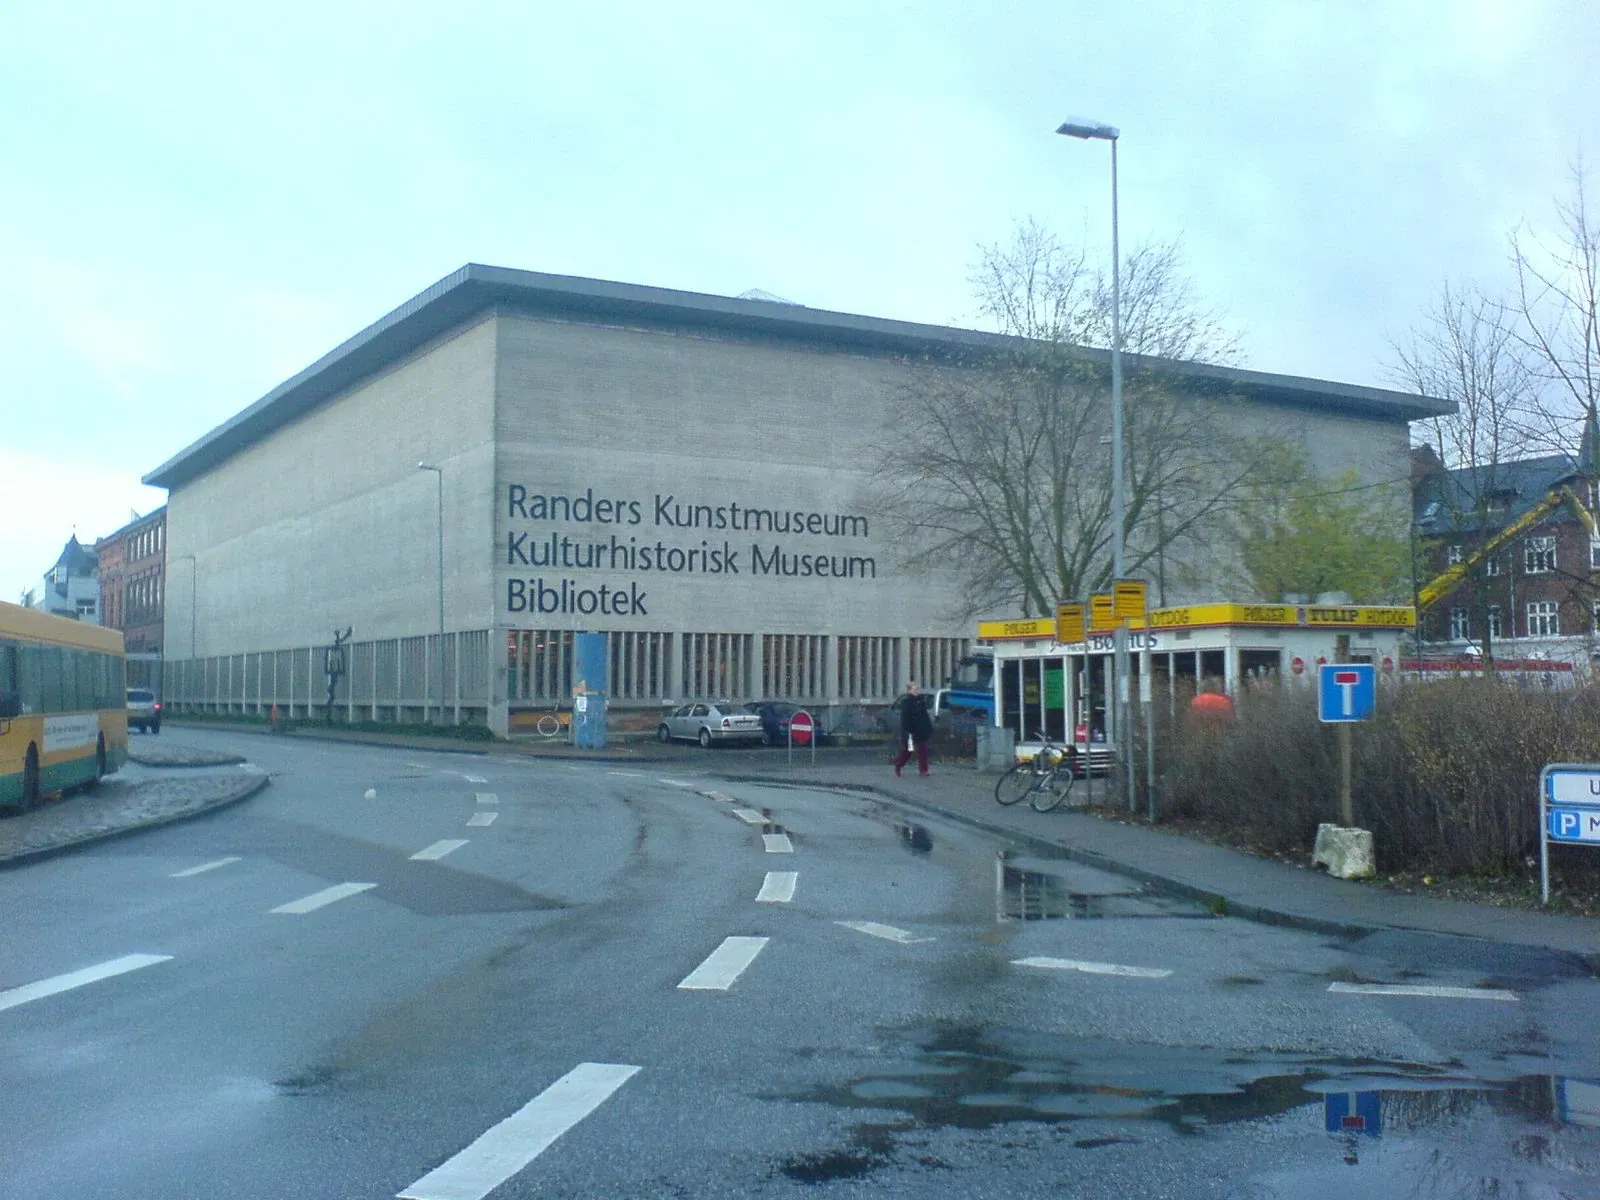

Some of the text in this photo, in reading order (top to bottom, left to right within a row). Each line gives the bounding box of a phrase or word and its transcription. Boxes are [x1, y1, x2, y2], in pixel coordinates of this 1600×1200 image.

[508, 483, 869, 538] Randers Kunstmuseum
[507, 531, 876, 579] Kulturhistorisk Museum
[507, 578, 648, 616] Bibliotek
[1309, 608, 1359, 622] TULIP
[1561, 813, 1577, 835] P
